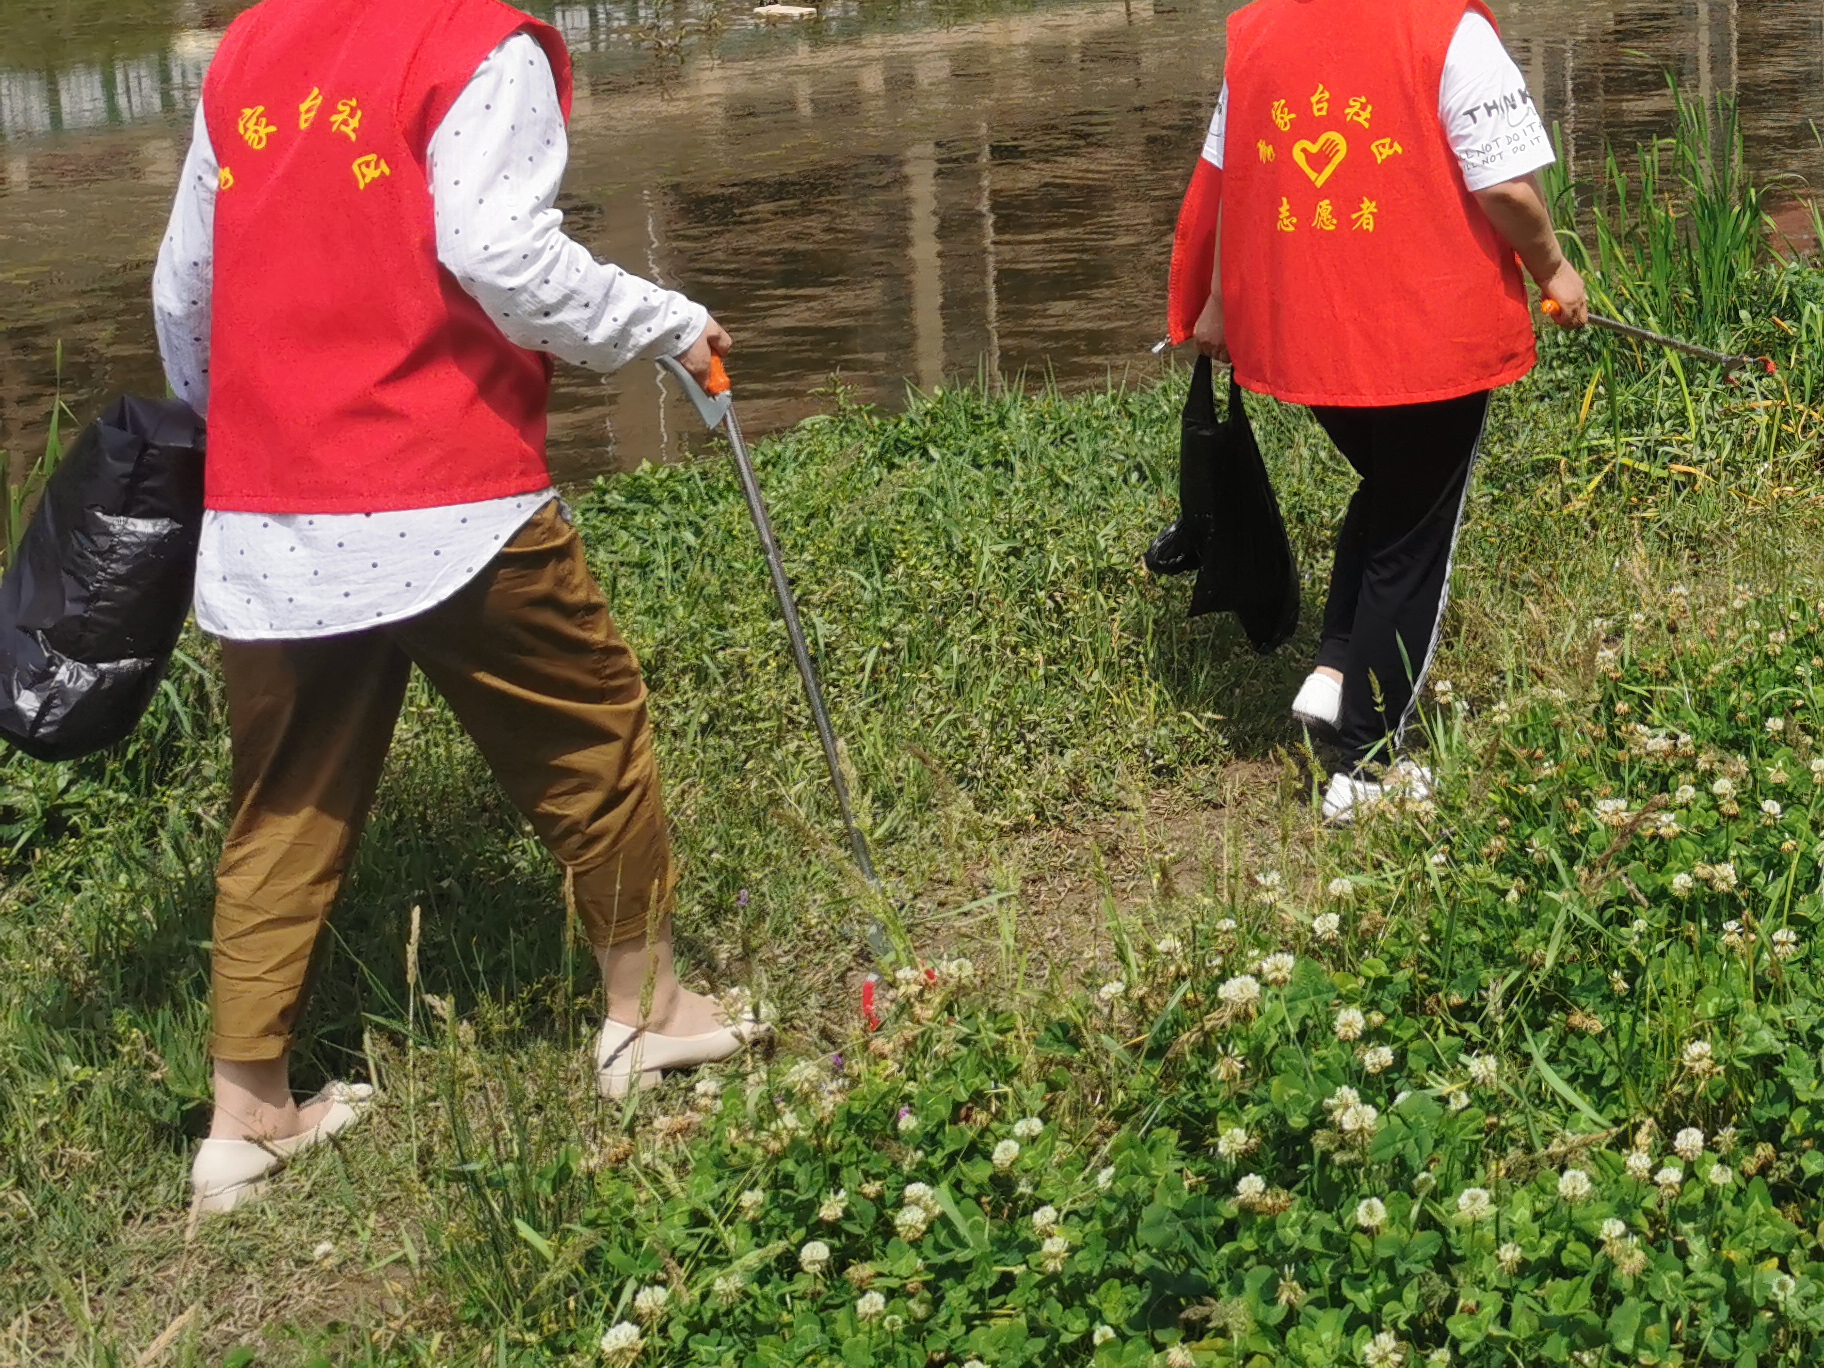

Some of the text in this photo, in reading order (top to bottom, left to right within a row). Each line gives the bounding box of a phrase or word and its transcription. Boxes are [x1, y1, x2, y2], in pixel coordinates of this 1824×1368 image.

[1505, 132, 1520, 146] DO
[1276, 195, 1379, 233] 志愿者
